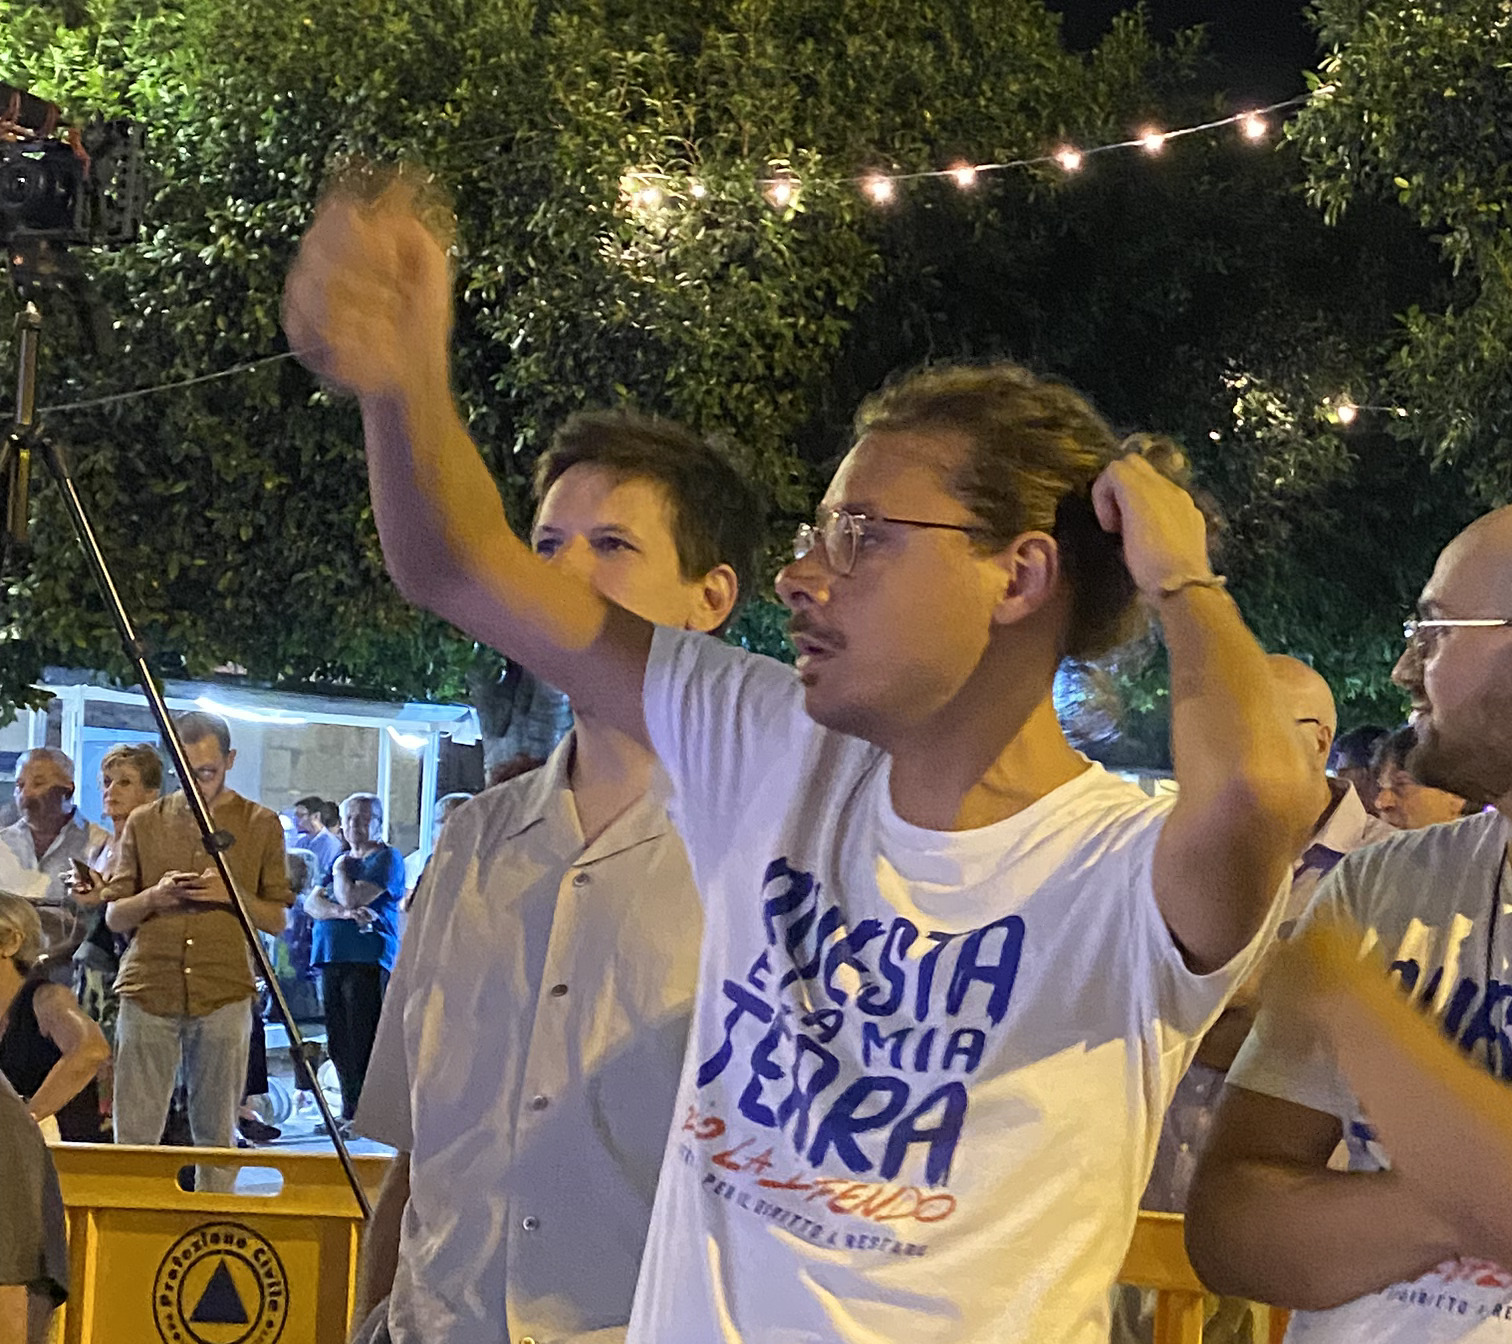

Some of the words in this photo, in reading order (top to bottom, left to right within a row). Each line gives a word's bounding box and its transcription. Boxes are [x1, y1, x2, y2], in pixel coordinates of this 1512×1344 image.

[696, 979, 968, 1188] TERRA
[862, 1022, 986, 1074] MIA
[160, 1231, 248, 1307] Protezione
[253, 1248, 283, 1312] Civile
